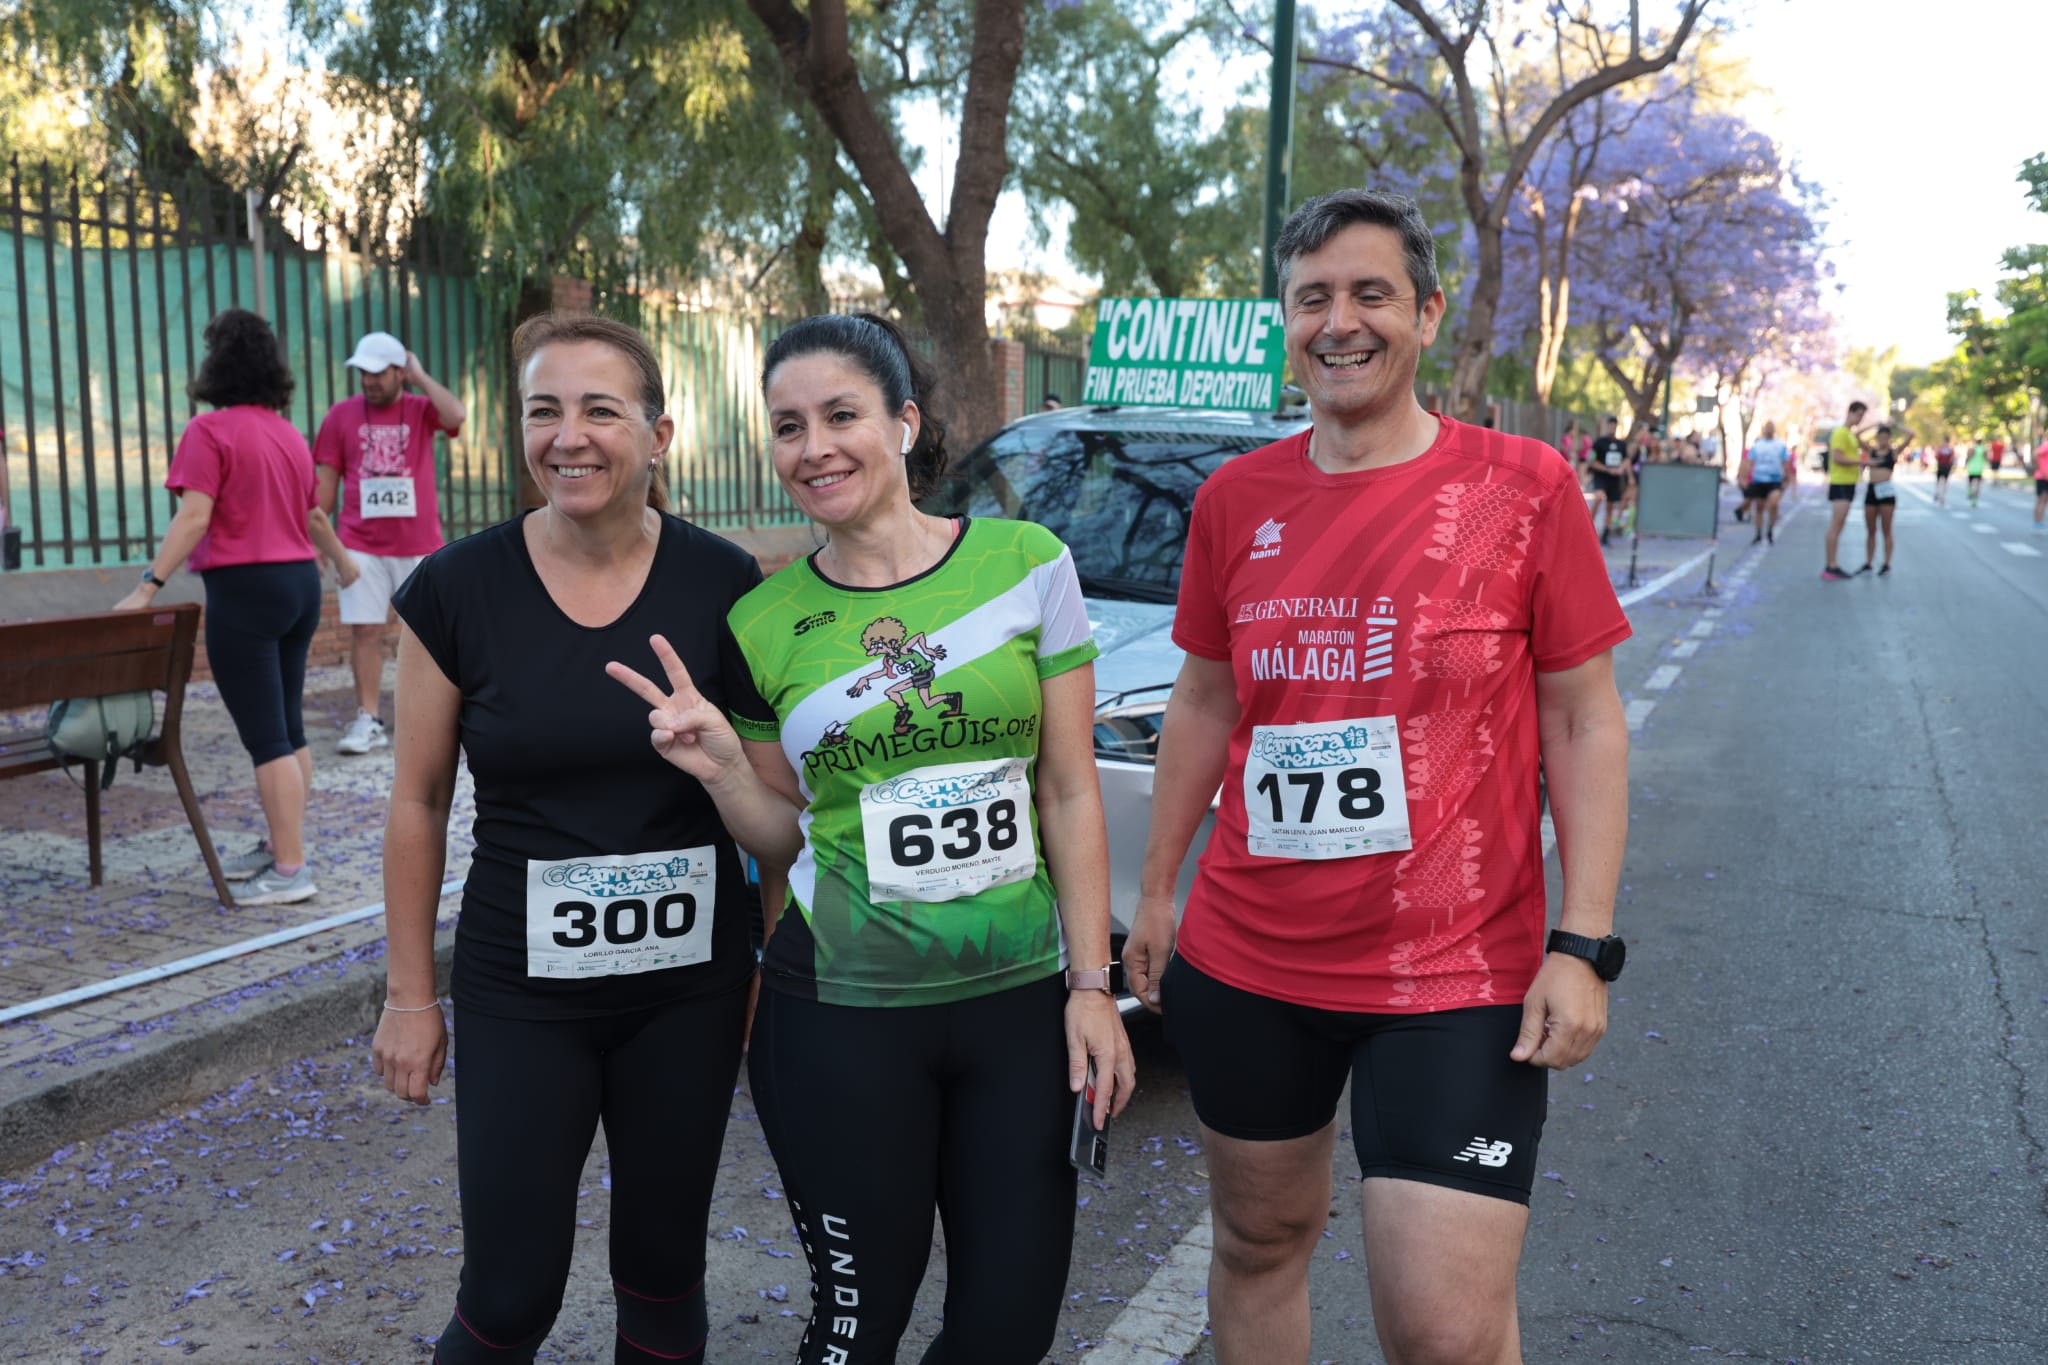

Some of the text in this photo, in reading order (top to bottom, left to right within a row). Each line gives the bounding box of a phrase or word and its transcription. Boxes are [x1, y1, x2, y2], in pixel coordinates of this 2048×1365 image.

[1084, 366, 1272, 409] FIN PRUEBA DEPORTIVA
[367, 491, 409, 506] 442
[1250, 546, 1281, 560] luanvi
[1255, 598, 1360, 620] GENERALI
[1298, 628, 1354, 645] MARATÓN
[1252, 641, 1356, 682] MÁLAGA
[1271, 747, 1355, 768] Prensa
[1257, 768, 1384, 823] 178
[889, 799, 1018, 866] 638
[1328, 825, 1365, 834] MARCELO
[982, 856, 1001, 864] MAYTE
[568, 863, 669, 884] Carrera
[587, 877, 675, 897] Prensa
[553, 893, 697, 948] 300
[584, 950, 614, 958] LOBILLO
[822, 1213, 859, 1365] UNDER
